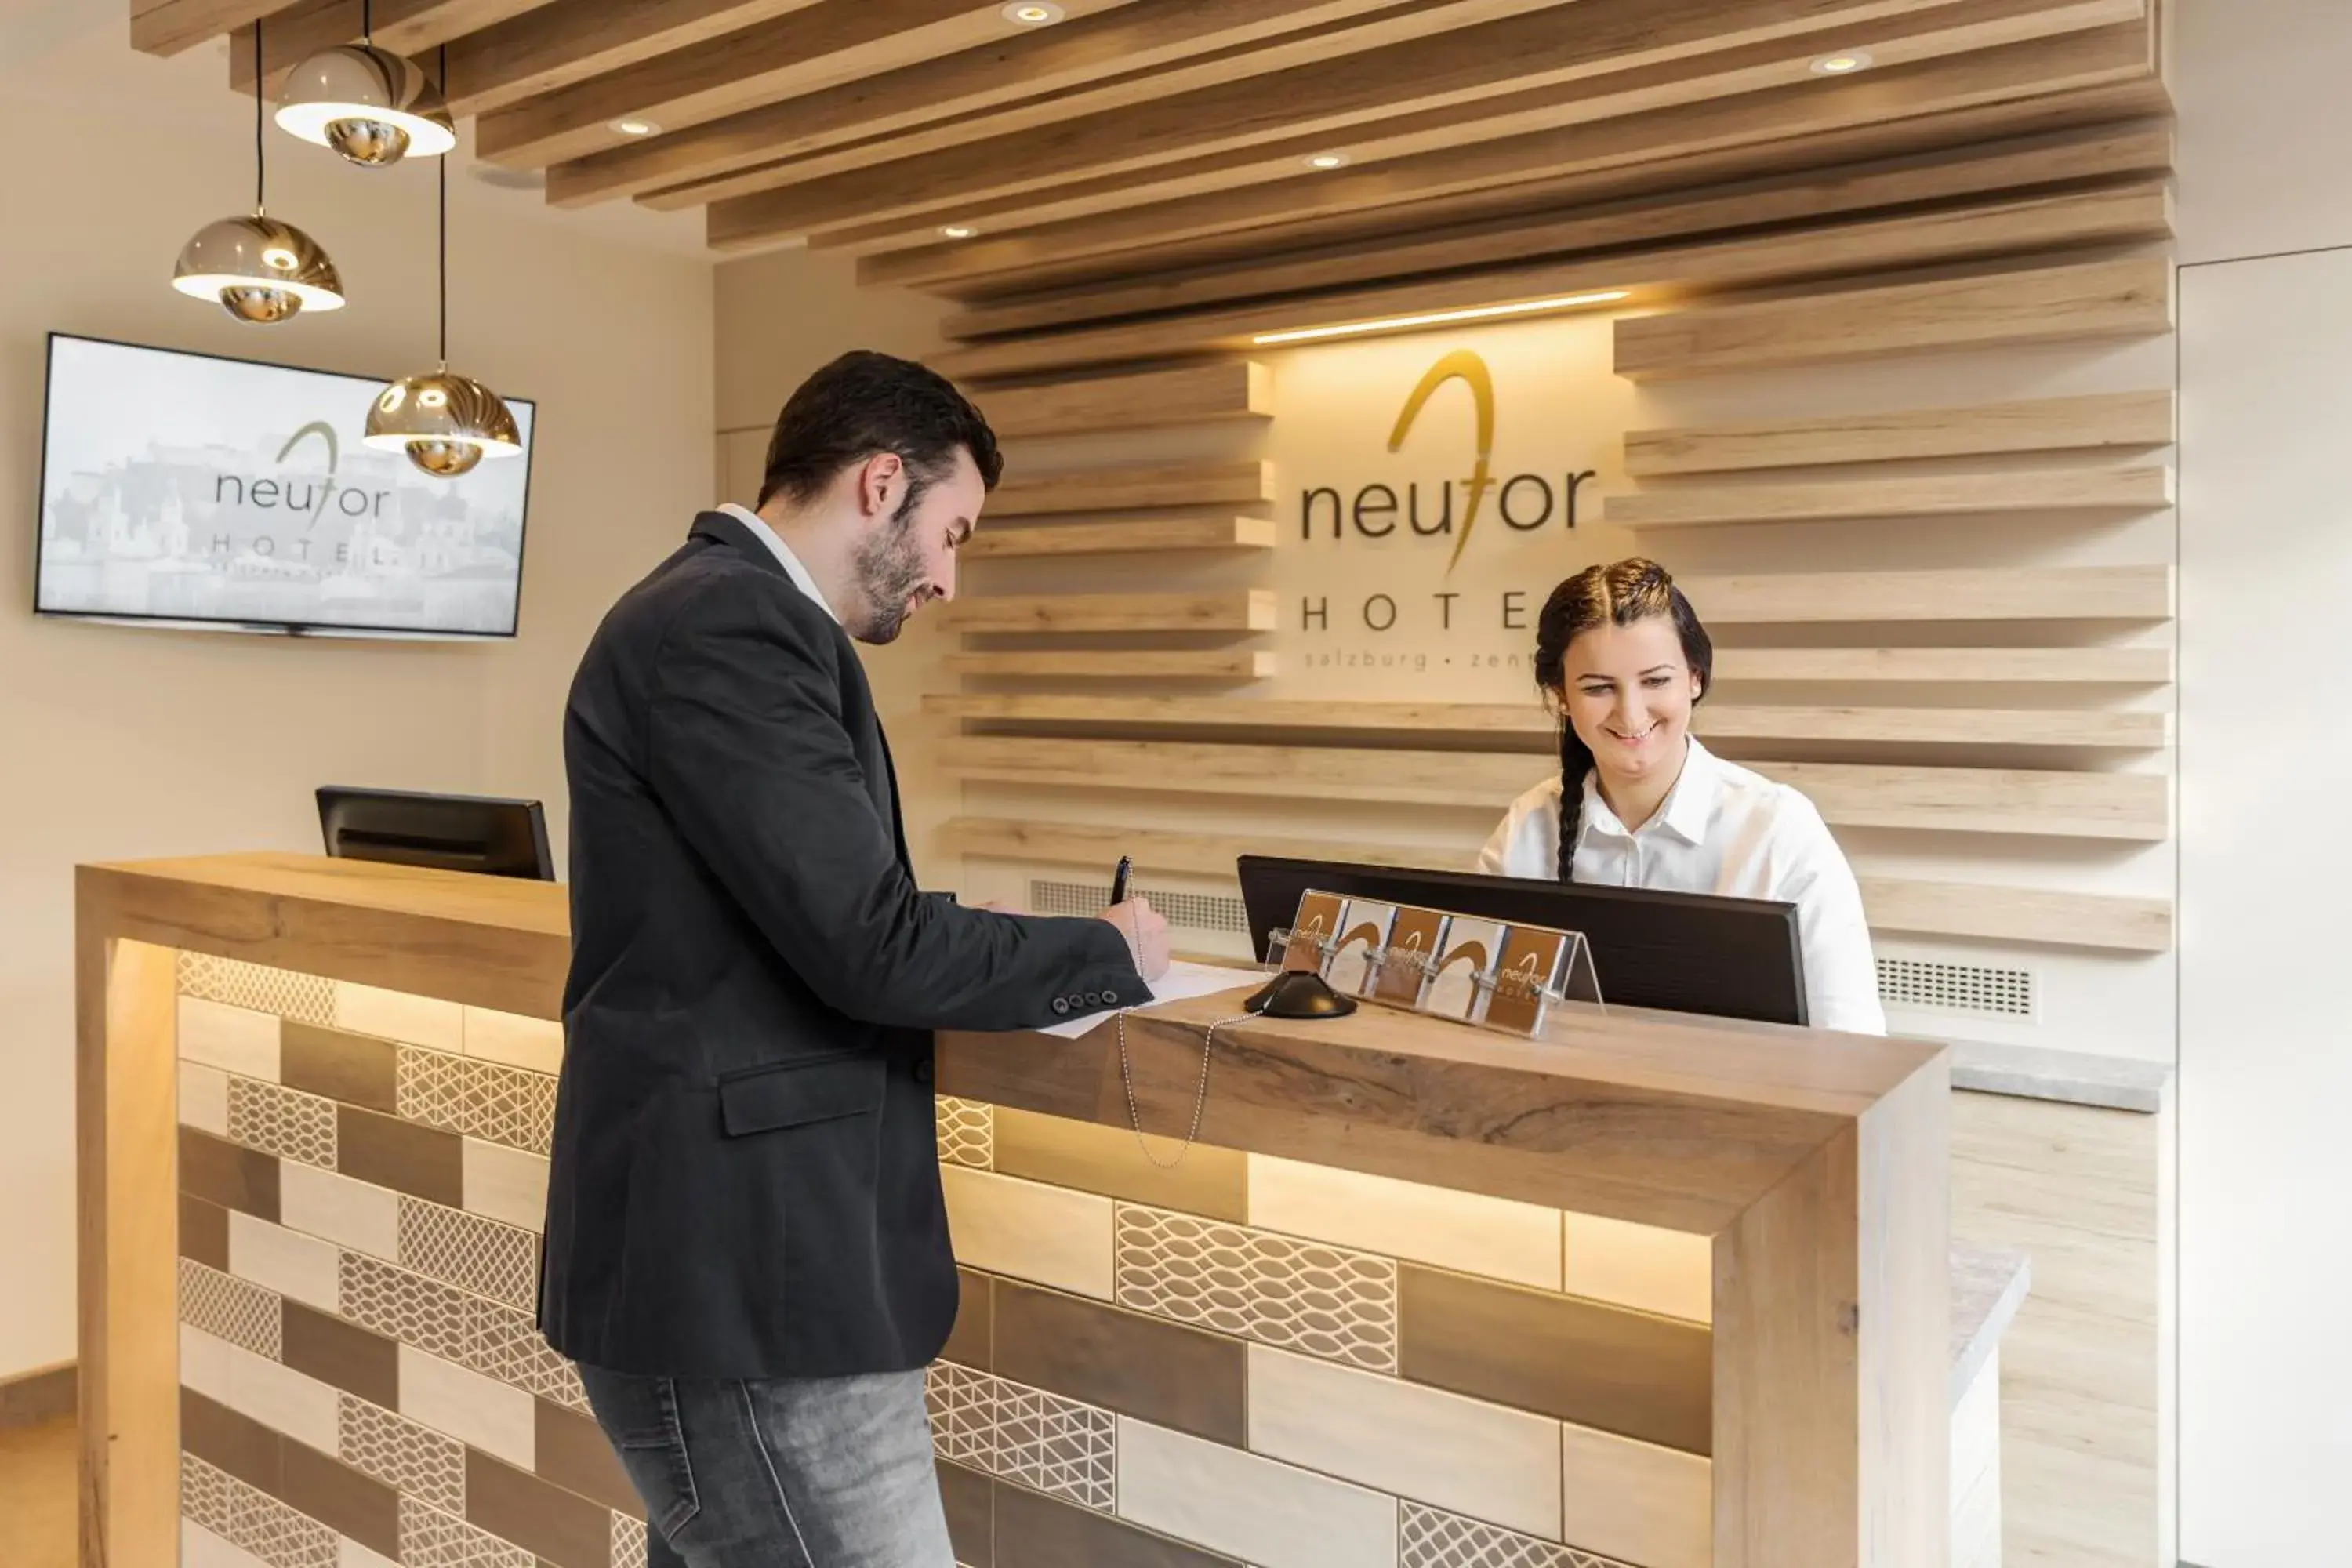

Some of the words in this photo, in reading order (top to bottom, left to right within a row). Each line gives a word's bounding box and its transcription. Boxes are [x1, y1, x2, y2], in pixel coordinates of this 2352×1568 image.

[212, 532, 385, 566] HOTEL
[1302, 591, 1526, 632] HOTE
[1305, 648, 1427, 672] salzburg
